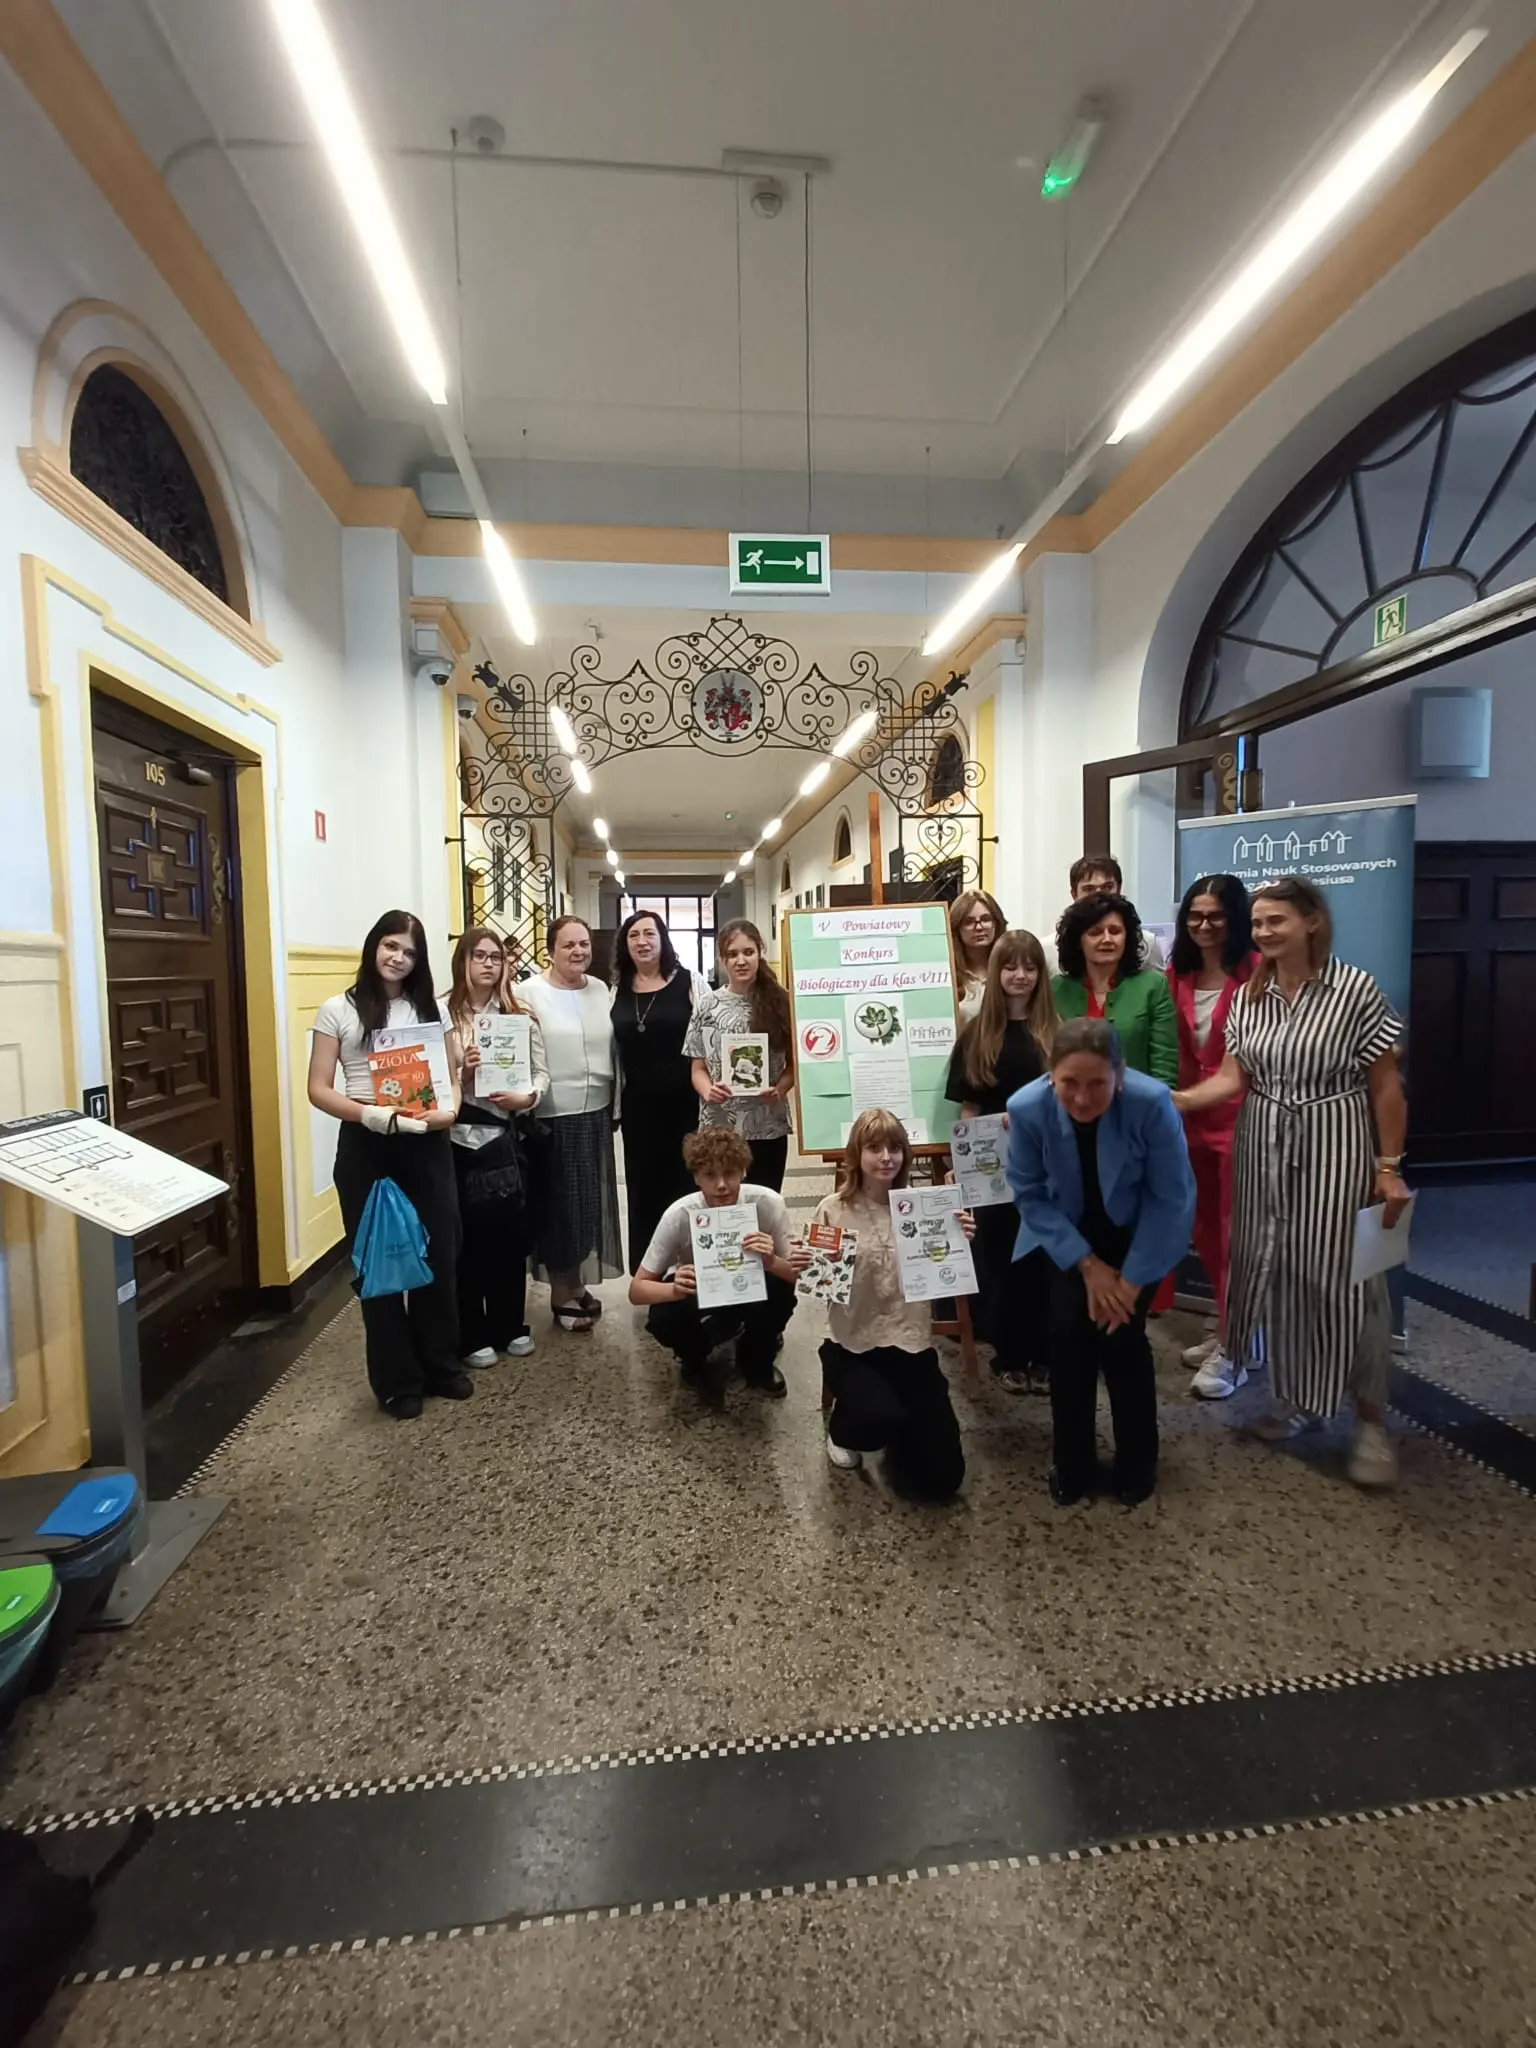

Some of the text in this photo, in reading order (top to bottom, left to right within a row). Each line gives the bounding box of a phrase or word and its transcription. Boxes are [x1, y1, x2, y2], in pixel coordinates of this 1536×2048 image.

[144, 761, 166, 787] 105
[1262, 865, 1298, 877] Nauk
[1300, 857, 1397, 874] Stosowanych
[818, 919, 911, 933] V Powiatowy
[842, 946, 894, 961] Konkurs
[798, 971, 949, 992] Biologiczny dla klas VIII
